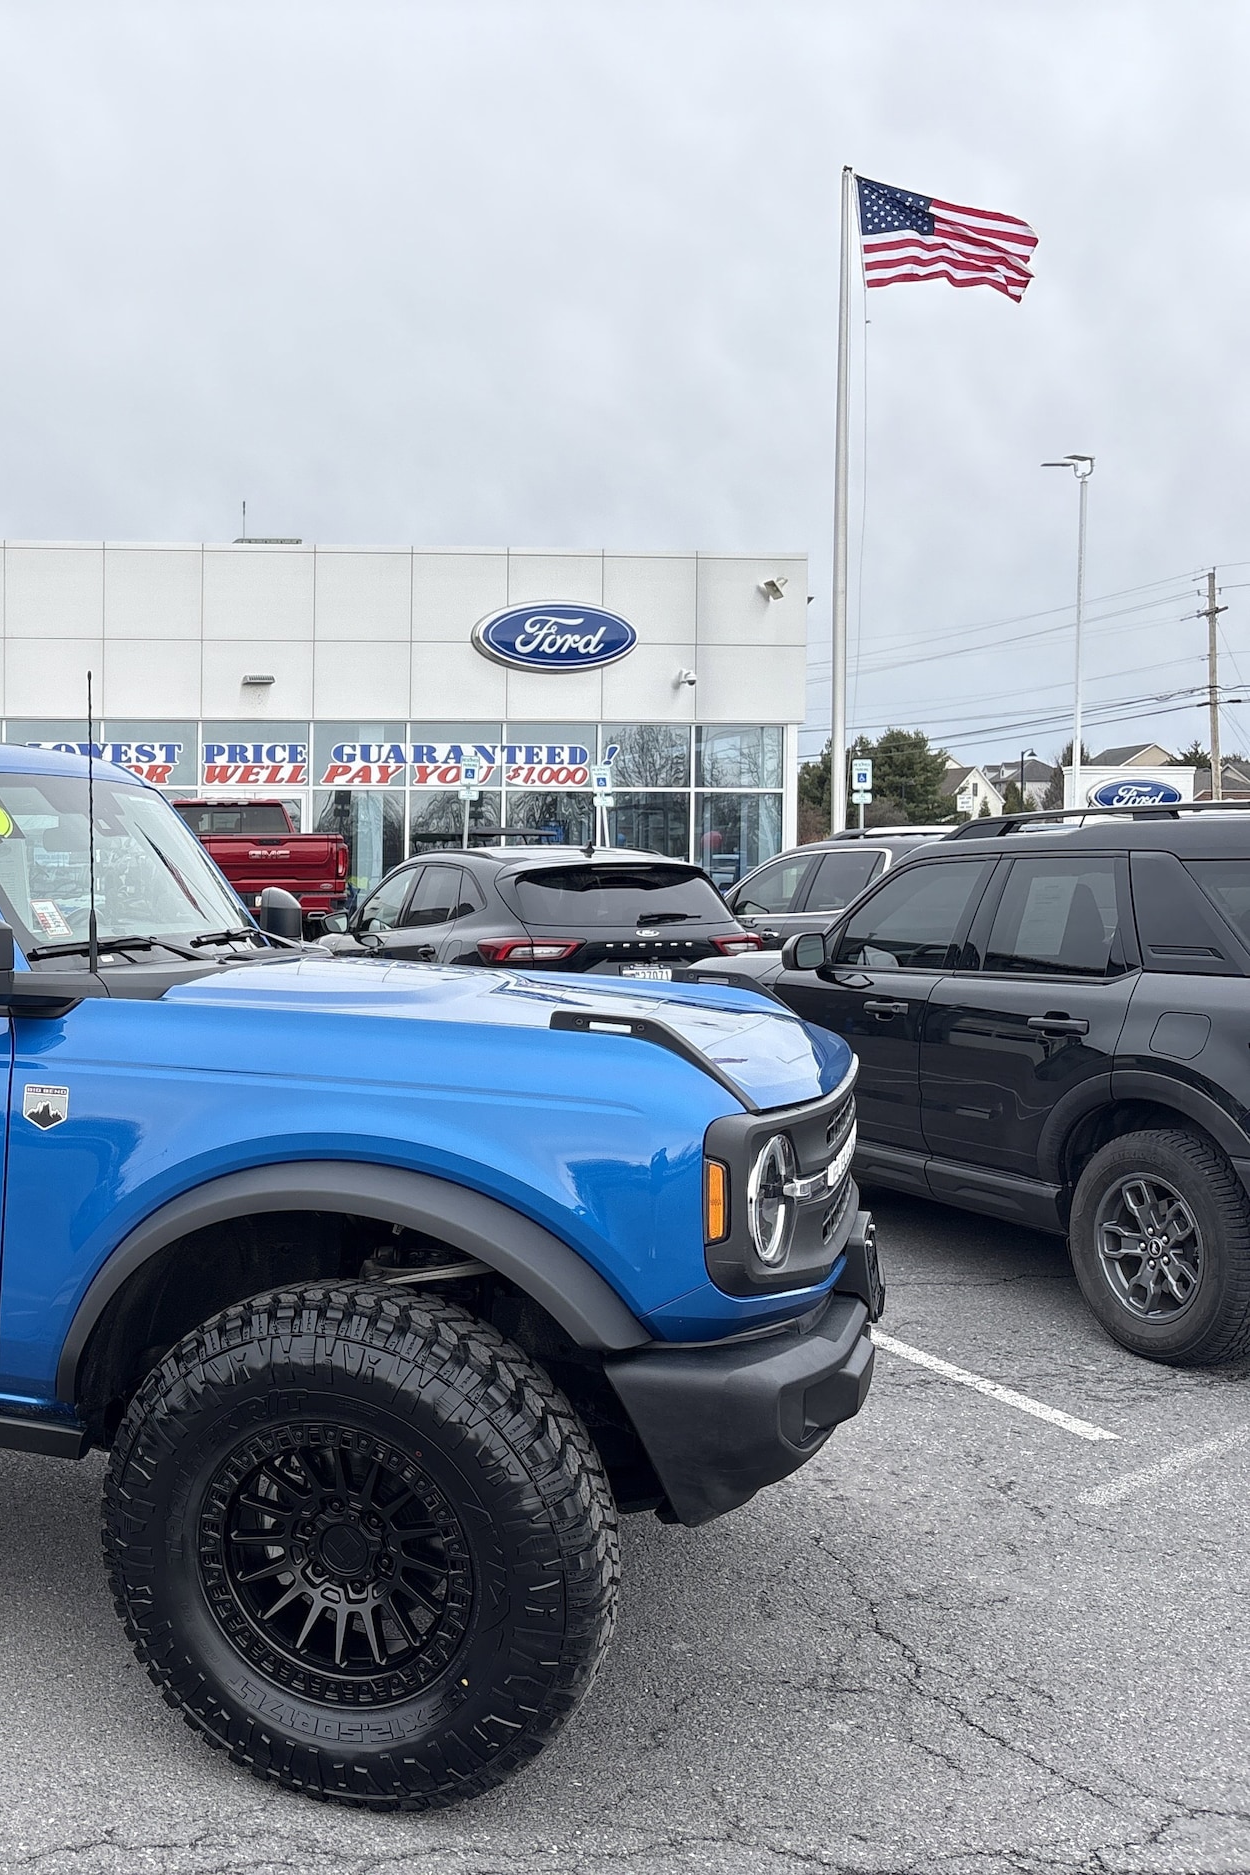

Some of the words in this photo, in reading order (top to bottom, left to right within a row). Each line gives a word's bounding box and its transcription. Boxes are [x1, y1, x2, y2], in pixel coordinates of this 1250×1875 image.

[515, 616, 606, 653] Ford
[28, 744, 182, 764] WEST
[203, 744, 307, 764] PRICE
[332, 744, 588, 765] GUARANTEED
[204, 764, 308, 784] WE'LL
[322, 764, 403, 784] PAY
[505, 765, 588, 785] $1,000
[1113, 785, 1165, 806] Ford
[248, 850, 291, 859] GMC
